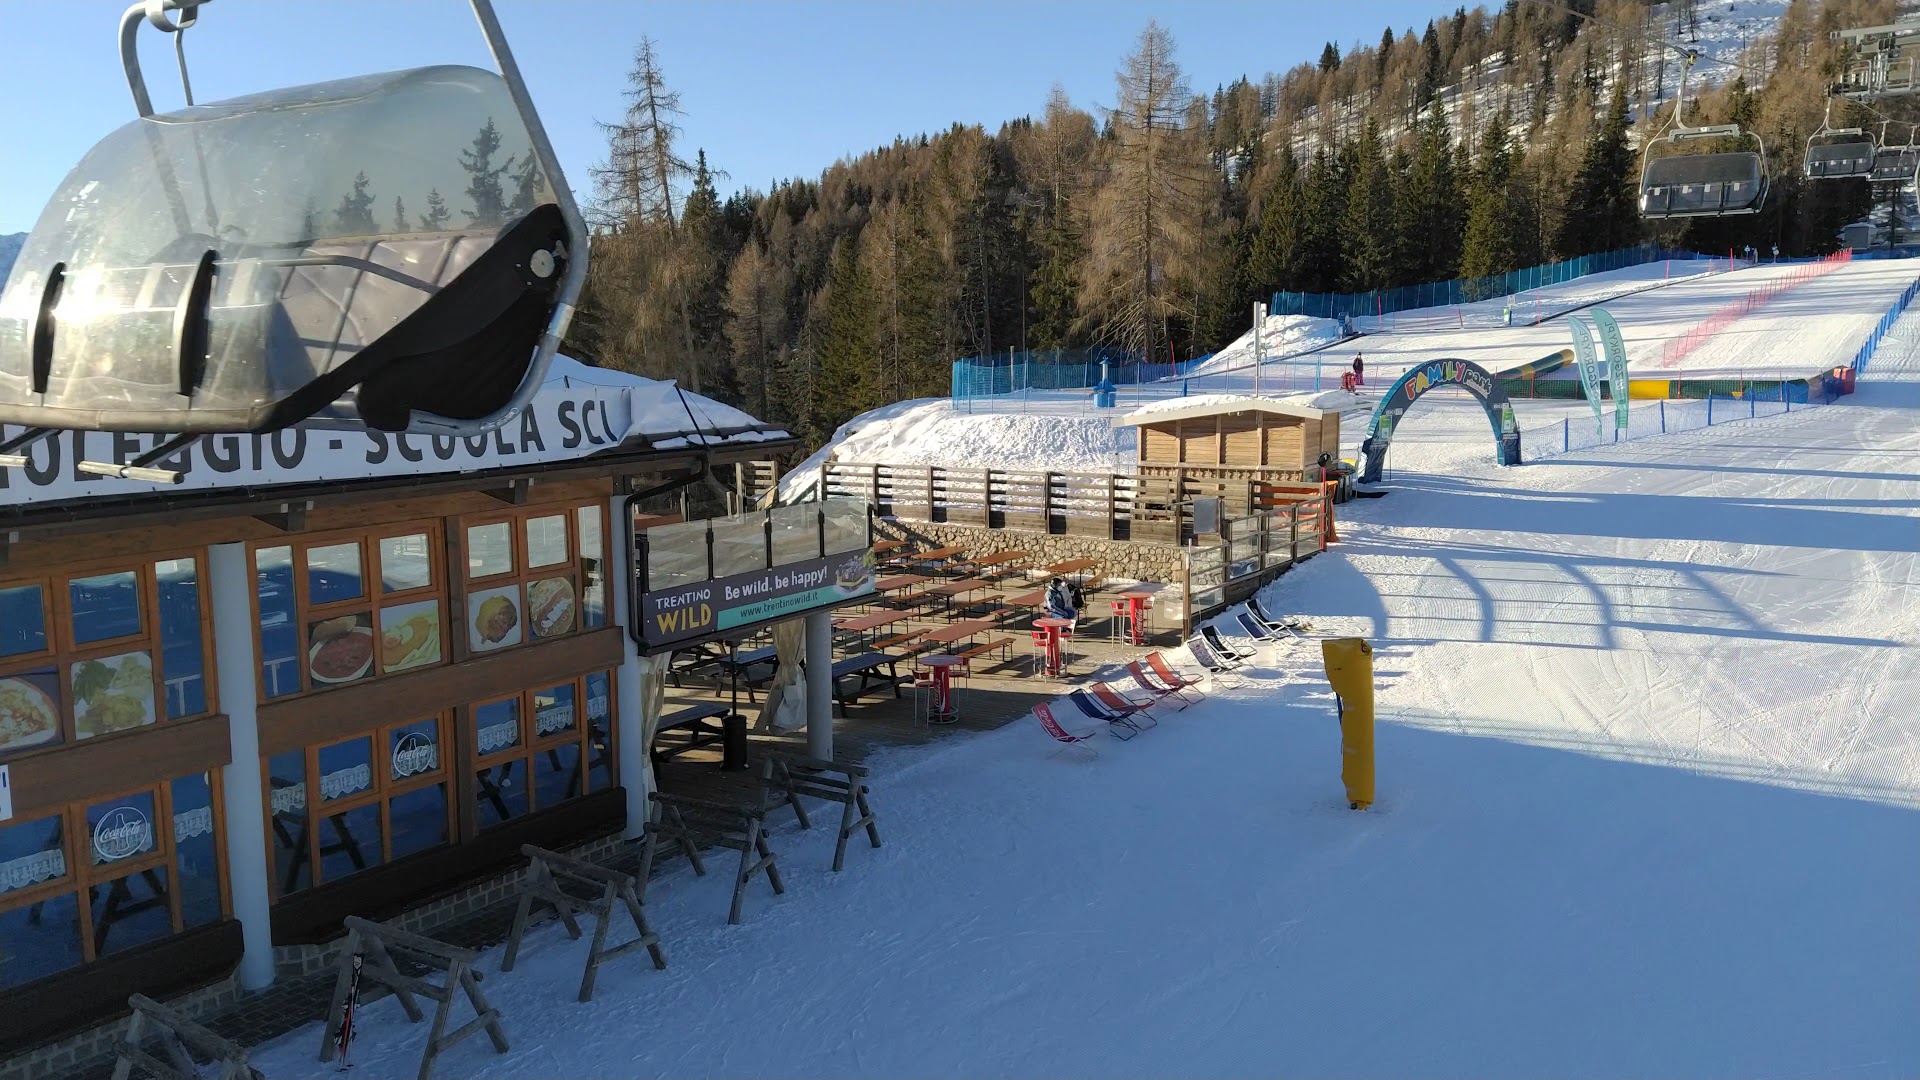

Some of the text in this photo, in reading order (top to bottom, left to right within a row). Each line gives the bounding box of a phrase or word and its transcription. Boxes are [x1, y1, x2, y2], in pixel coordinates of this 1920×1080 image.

[1404, 361, 1466, 400] FAMILY
[1463, 368, 1493, 395] park
[0, 424, 307, 489] OLEGIO
[557, 400, 618, 449] SCI
[656, 588, 711, 610] TRENTINO
[724, 565, 828, 601] Be wild, be happy!
[656, 603, 712, 635] WILD
[740, 591, 818, 618] www.trentinowild.it
